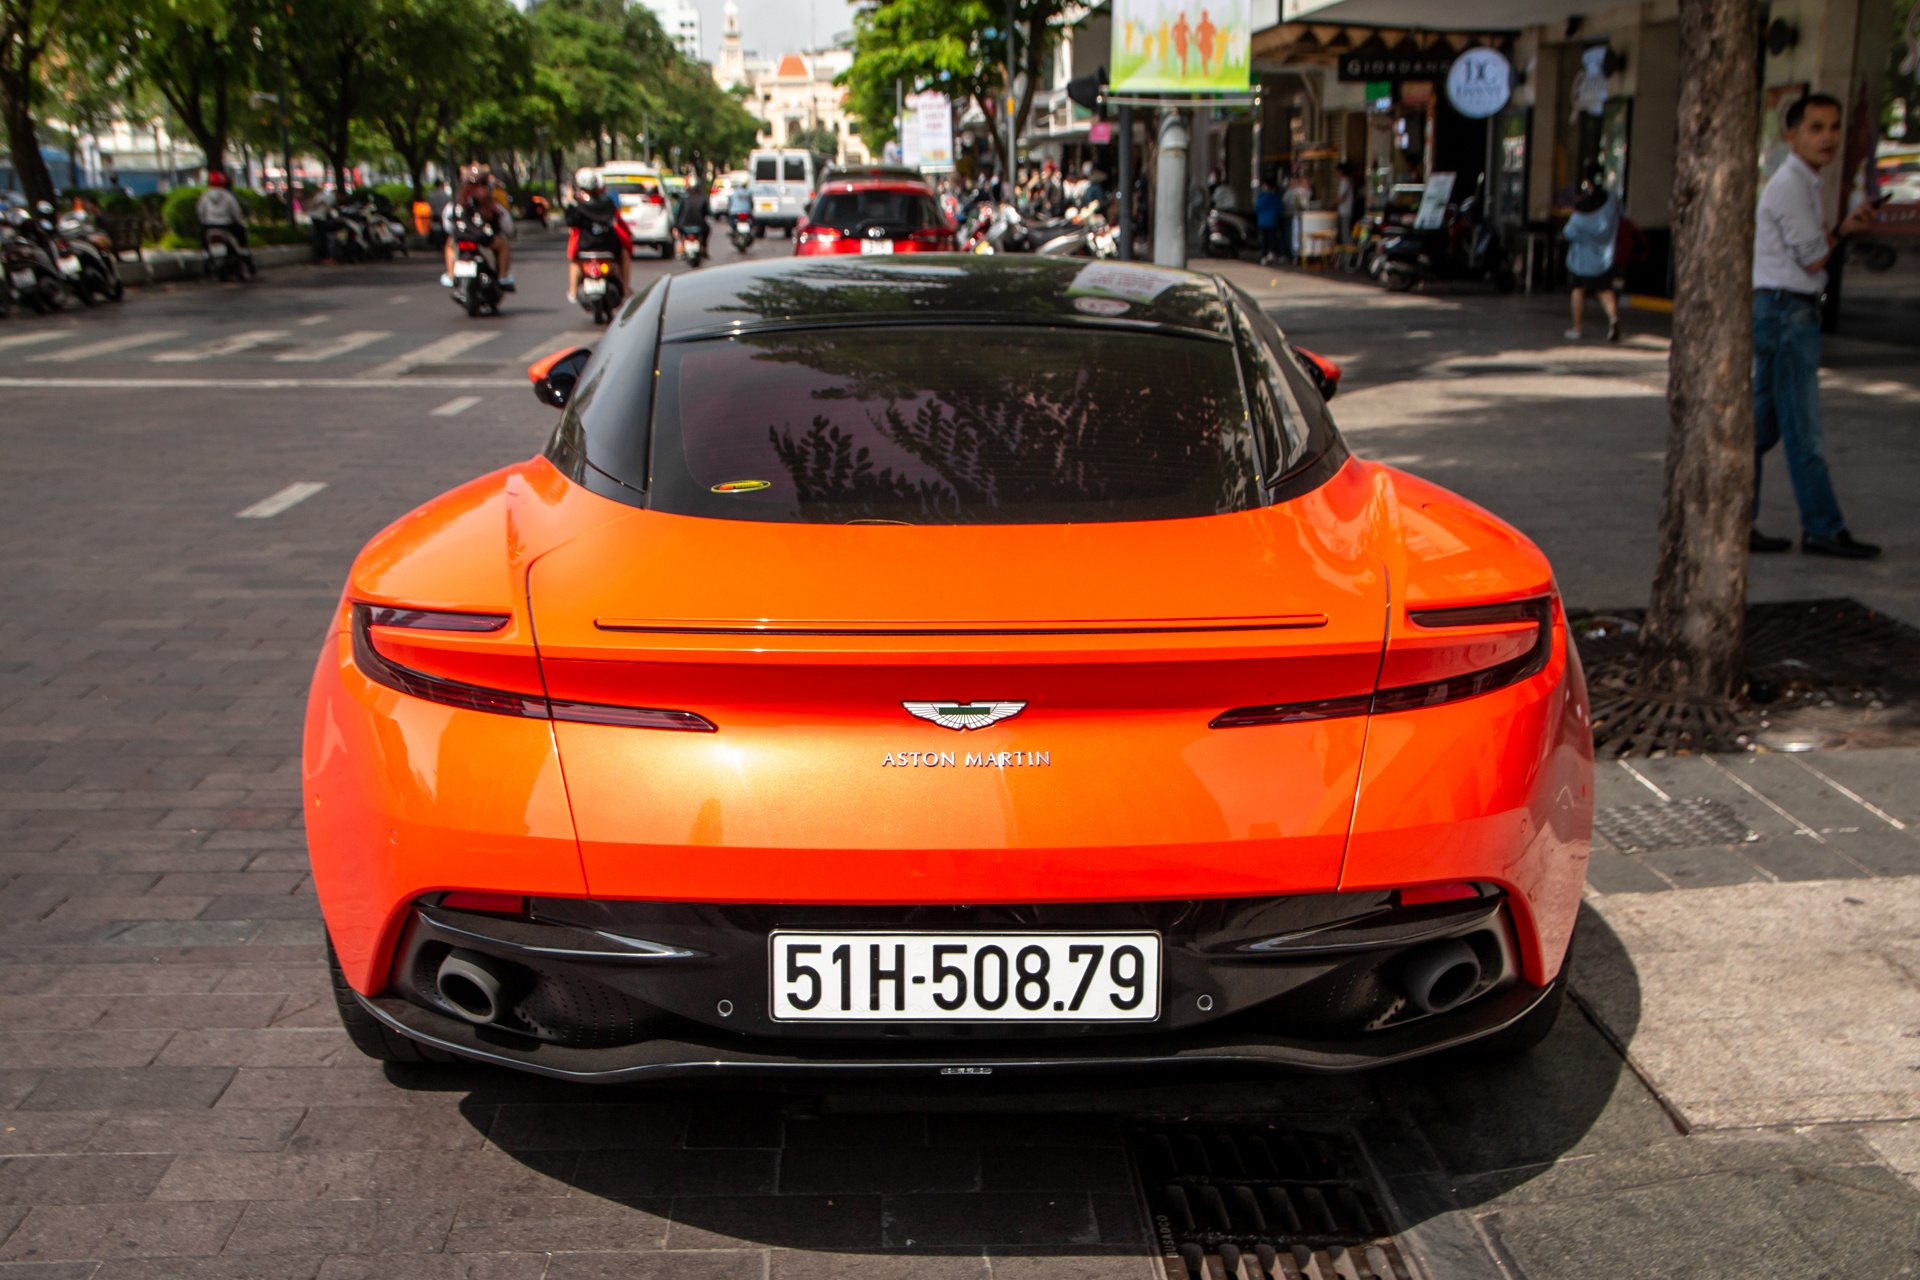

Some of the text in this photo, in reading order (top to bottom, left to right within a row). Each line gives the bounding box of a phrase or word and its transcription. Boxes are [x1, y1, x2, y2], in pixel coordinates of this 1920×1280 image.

[882, 751, 1051, 768] ASTON MARTIN
[786, 943, 1144, 1011] 51H-508.79
[1156, 1215, 1179, 1258] BUSADCO
